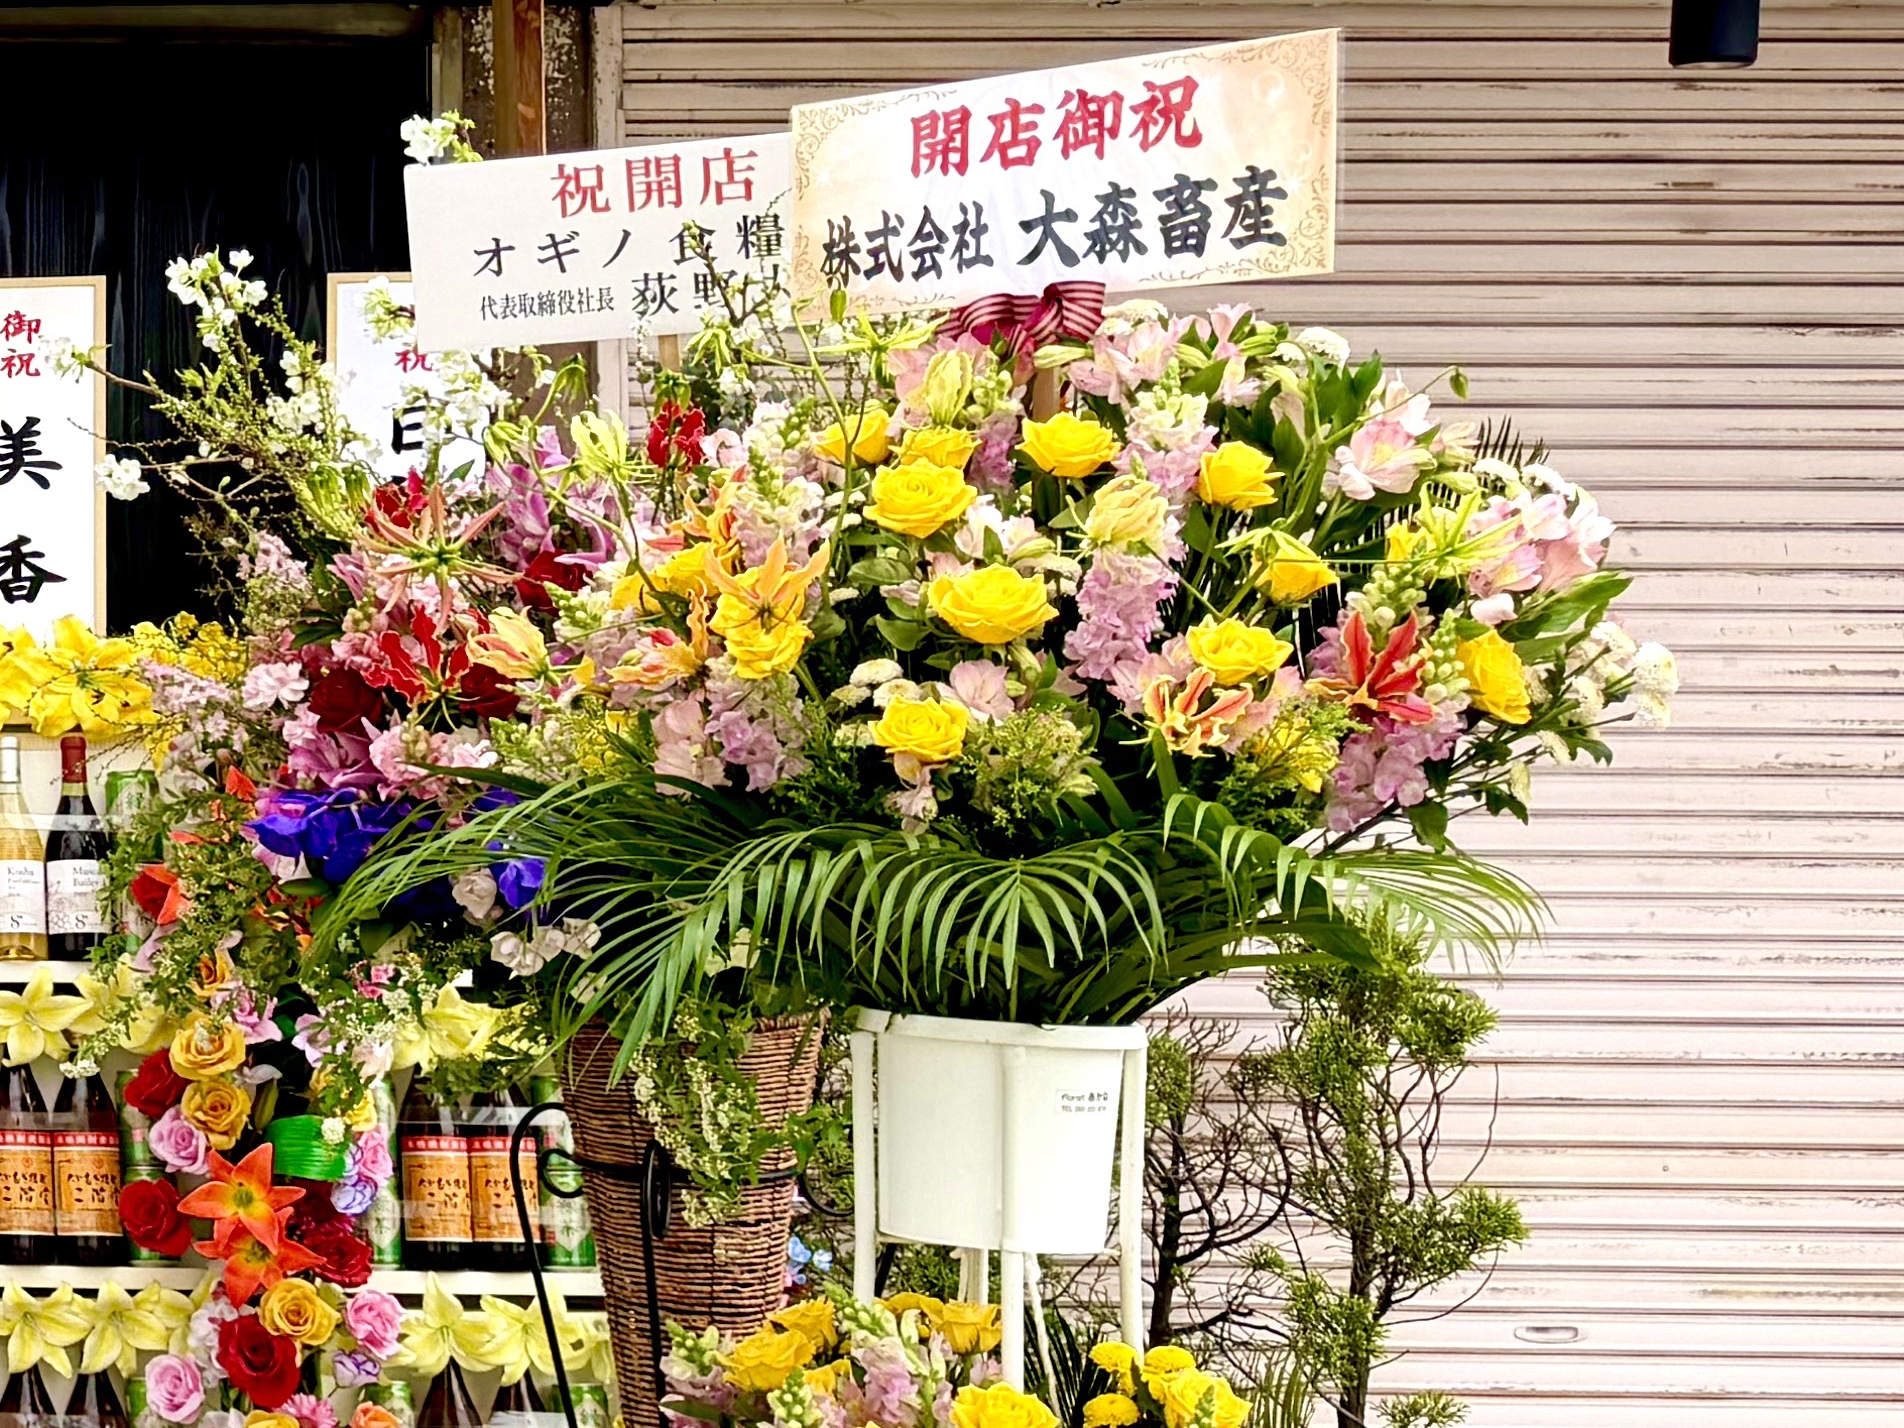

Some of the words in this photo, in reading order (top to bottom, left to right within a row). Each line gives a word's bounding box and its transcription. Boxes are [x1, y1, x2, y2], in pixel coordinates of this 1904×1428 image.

[908, 74, 1203, 179] 開店御祝
[551, 147, 759, 219] 祝開店
[820, 198, 995, 290] 株式会社
[1016, 164, 1290, 269] 大森畜産
[480, 285, 615, 322] 代表取締役社長
[0, 310, 42, 379] 御祝
